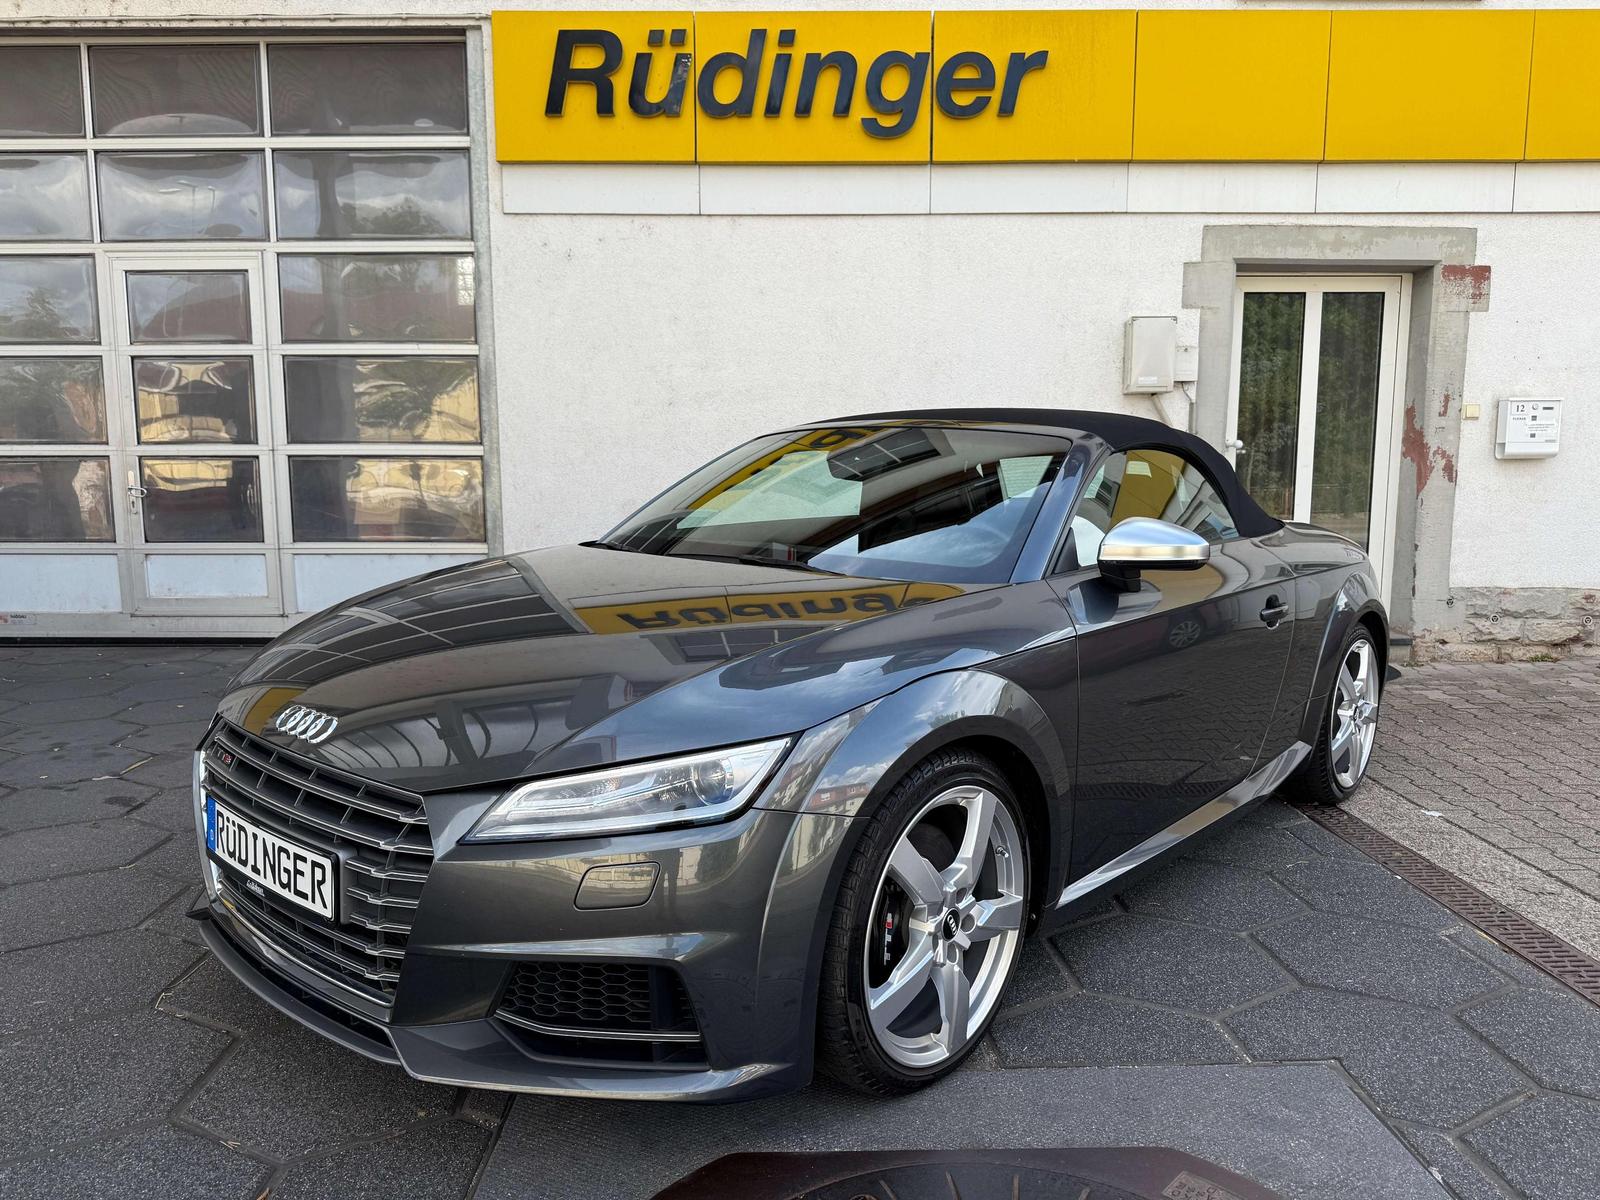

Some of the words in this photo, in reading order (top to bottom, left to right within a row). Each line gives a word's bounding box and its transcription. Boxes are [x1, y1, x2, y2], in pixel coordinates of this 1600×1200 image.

[544, 28, 1049, 140] Rüdinger
[1516, 404, 1525, 412] 12
[216, 809, 328, 910] RÜDINGER
